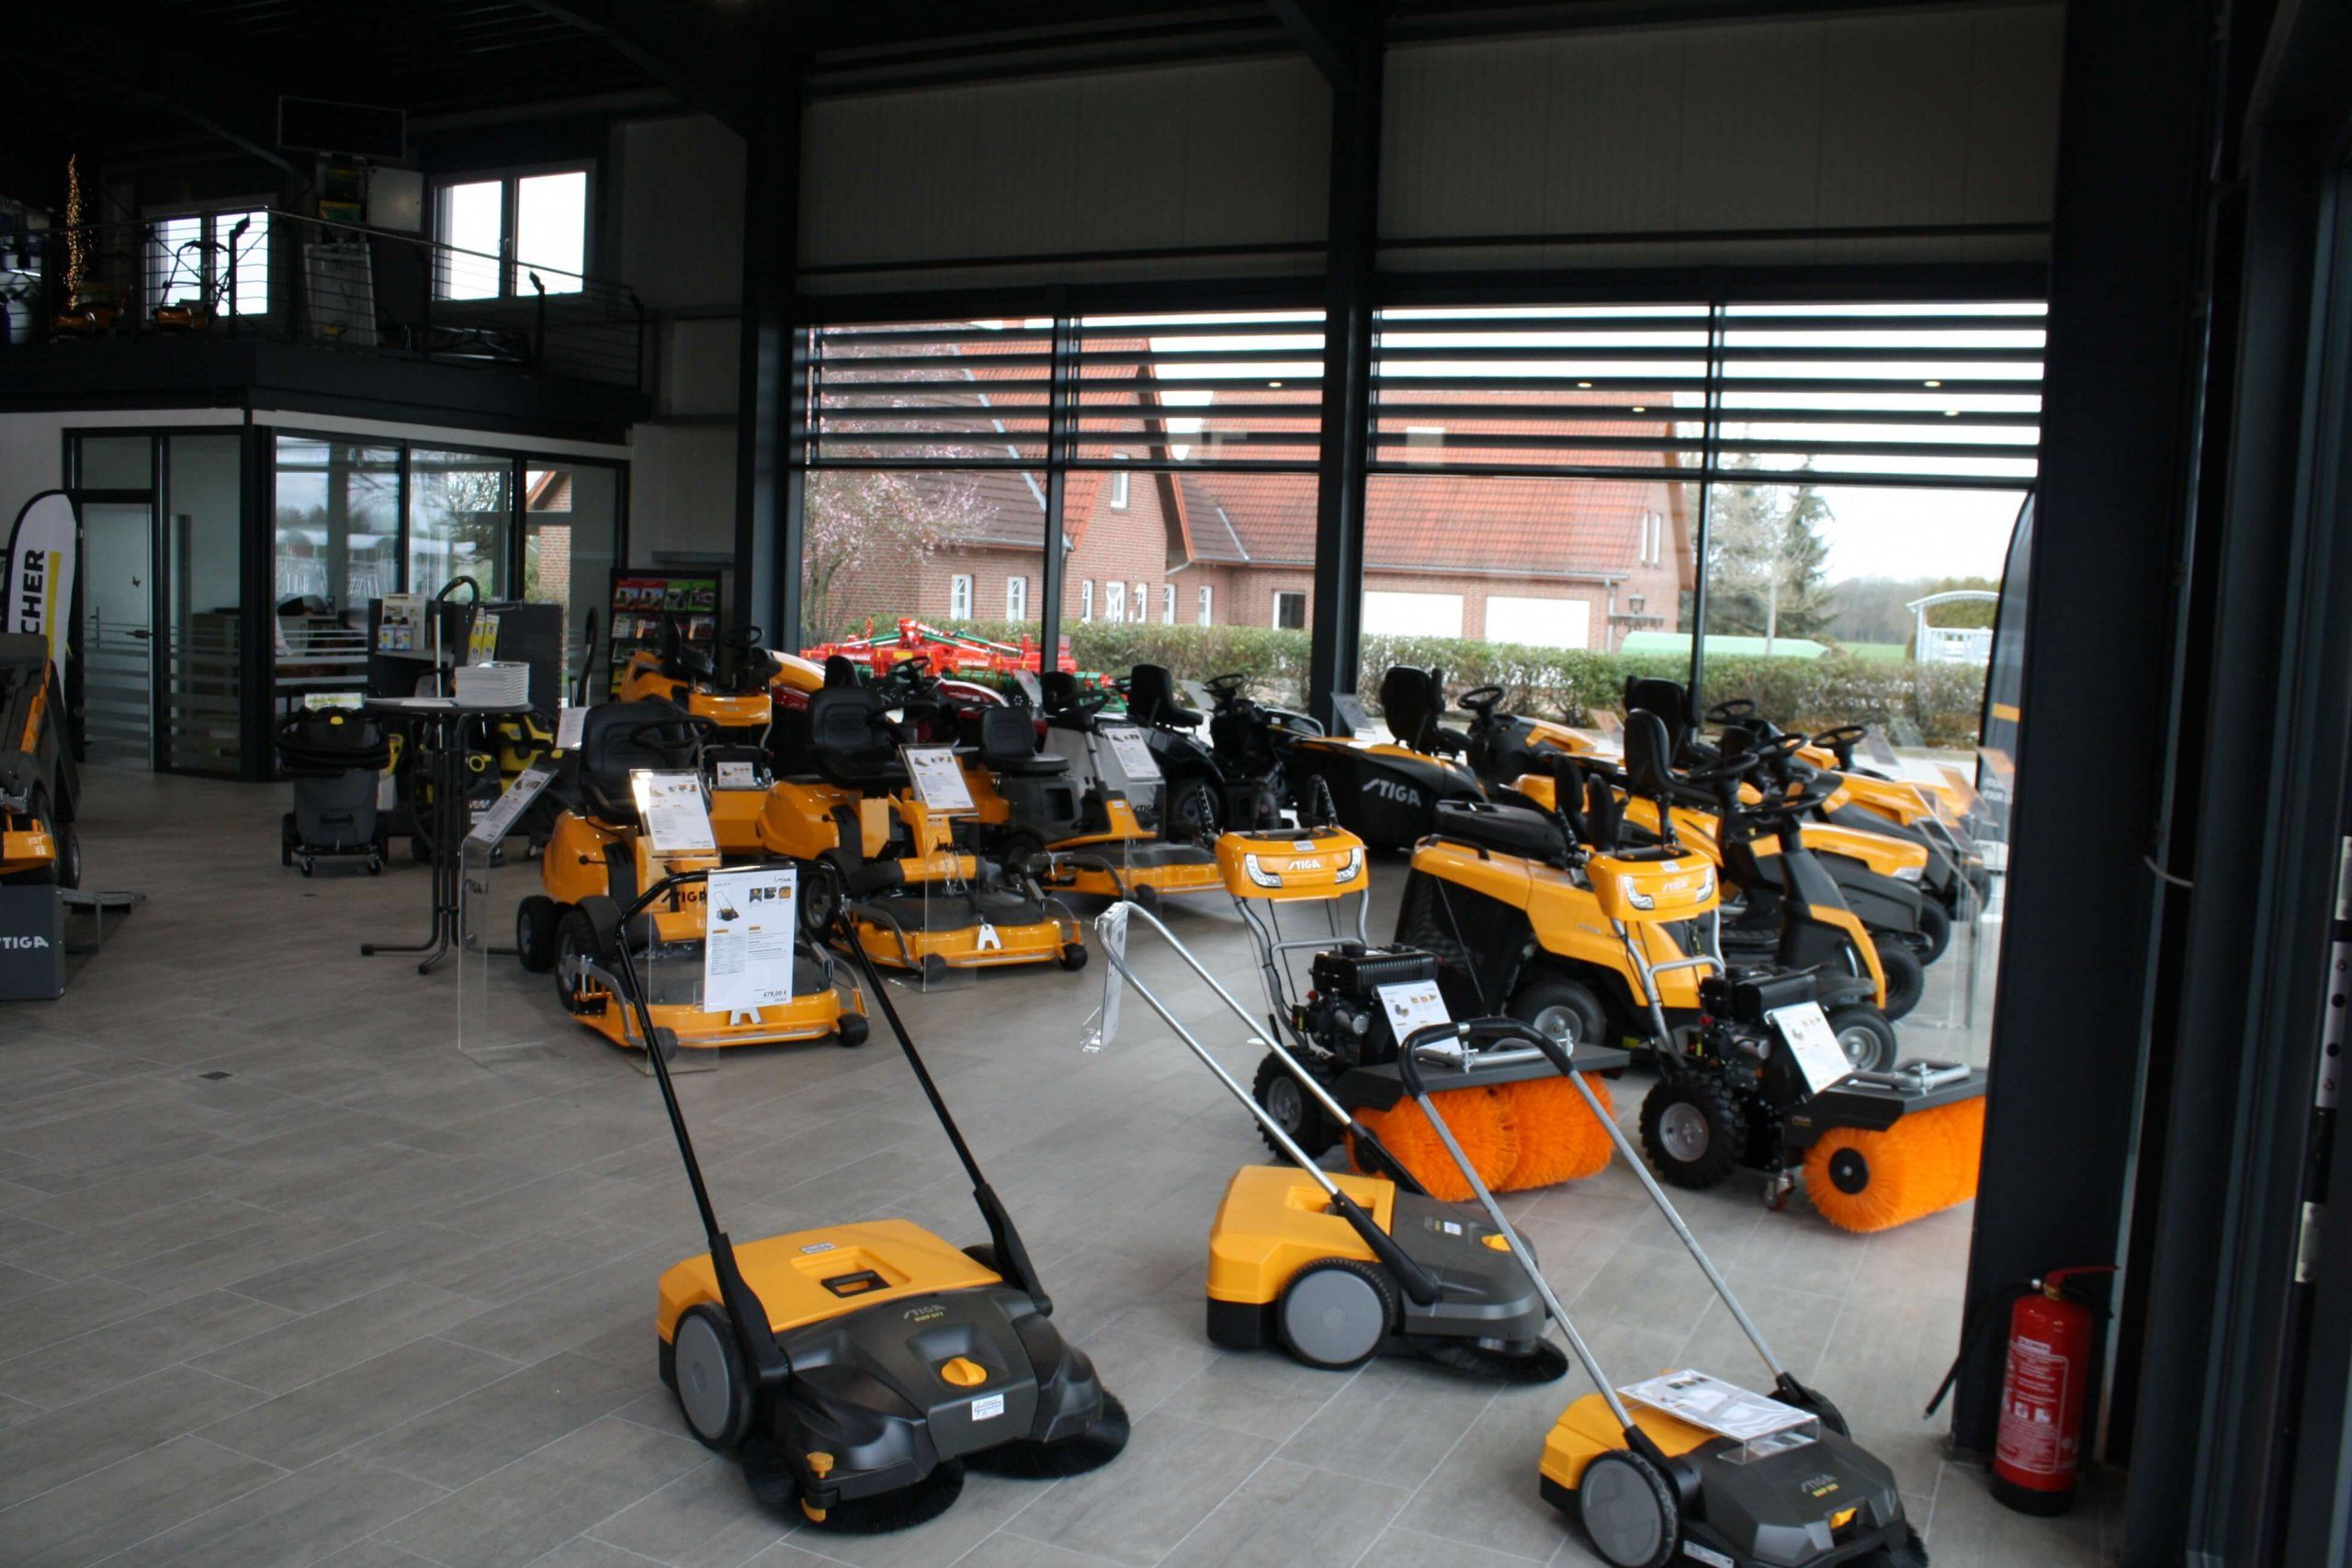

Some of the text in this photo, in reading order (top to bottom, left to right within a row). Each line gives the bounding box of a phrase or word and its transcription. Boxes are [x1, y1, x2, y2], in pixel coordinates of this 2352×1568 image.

[1362, 777, 1422, 808] STIGA
[1288, 860, 1321, 871] STIGA
[0, 935, 50, 950] TIGA
